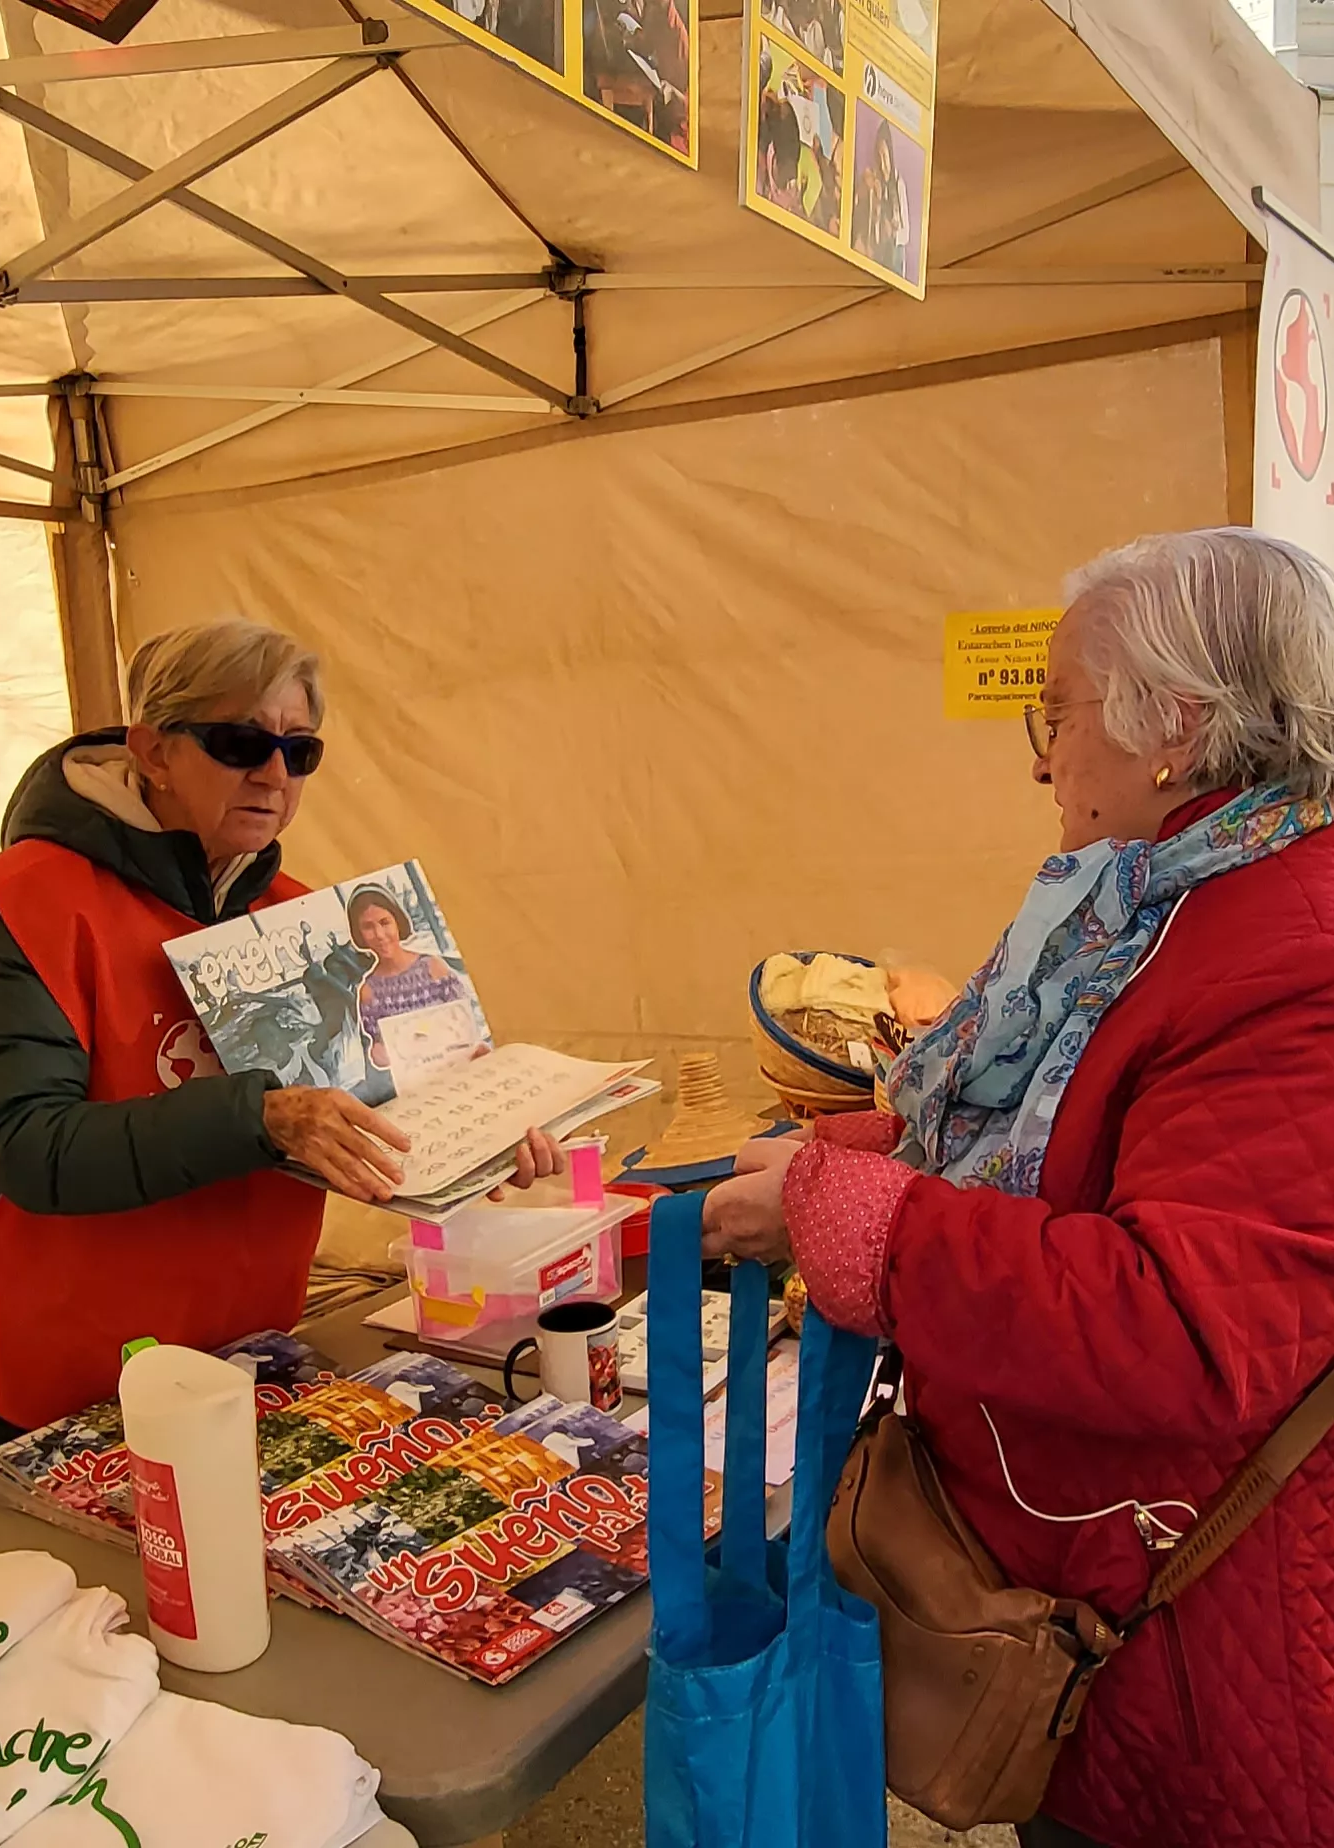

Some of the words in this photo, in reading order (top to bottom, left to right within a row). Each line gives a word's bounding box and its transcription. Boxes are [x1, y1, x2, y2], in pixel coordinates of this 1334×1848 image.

[999, 667, 1046, 686] 93.88
[143, 1544, 182, 1566] LOBAL
[365, 1549, 419, 1594] un
